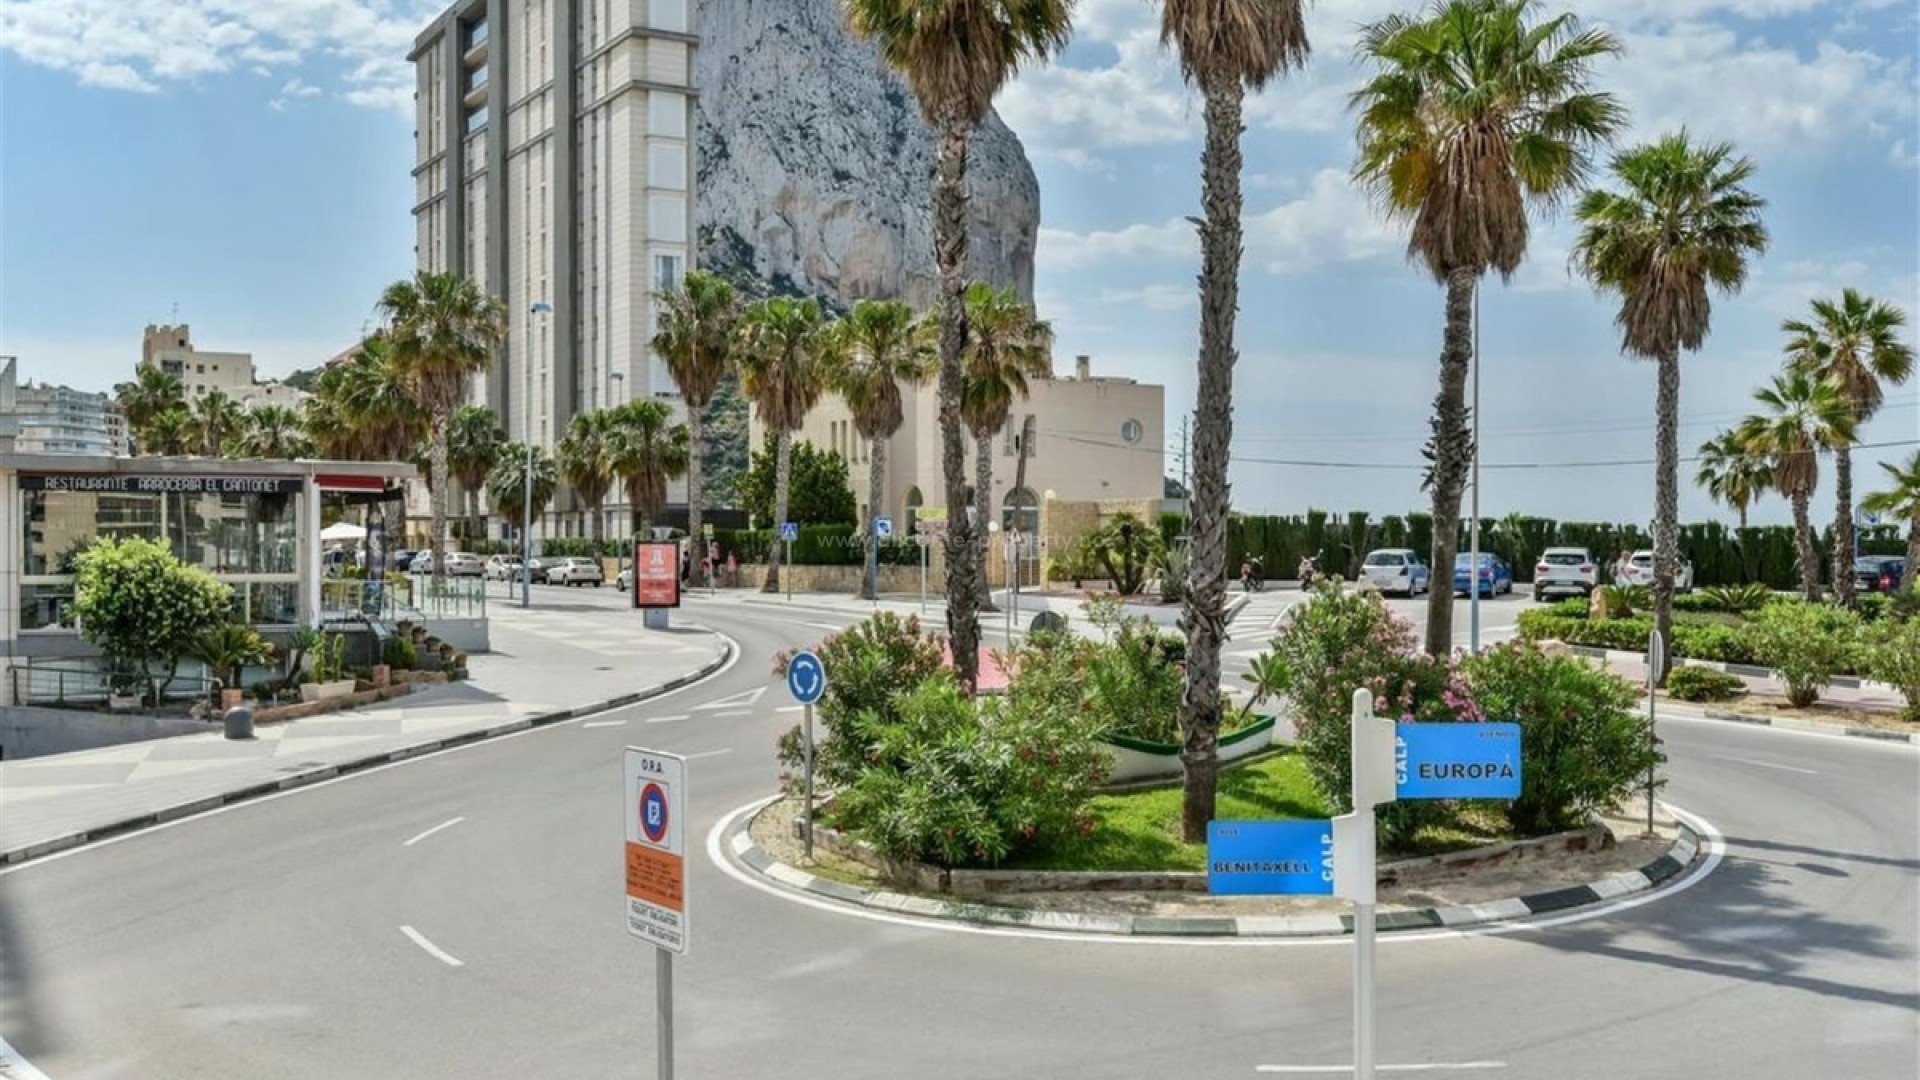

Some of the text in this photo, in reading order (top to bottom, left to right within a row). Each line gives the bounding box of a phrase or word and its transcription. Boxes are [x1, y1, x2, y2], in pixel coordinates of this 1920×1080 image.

[45, 476, 128, 490] RESTAURANTE
[206, 478, 220, 492] EL
[1396, 735, 1408, 785] CALP
[1419, 762, 1514, 779] EUROPA
[1321, 833, 1334, 882] CALP
[1214, 861, 1311, 874] BENITAXELL
